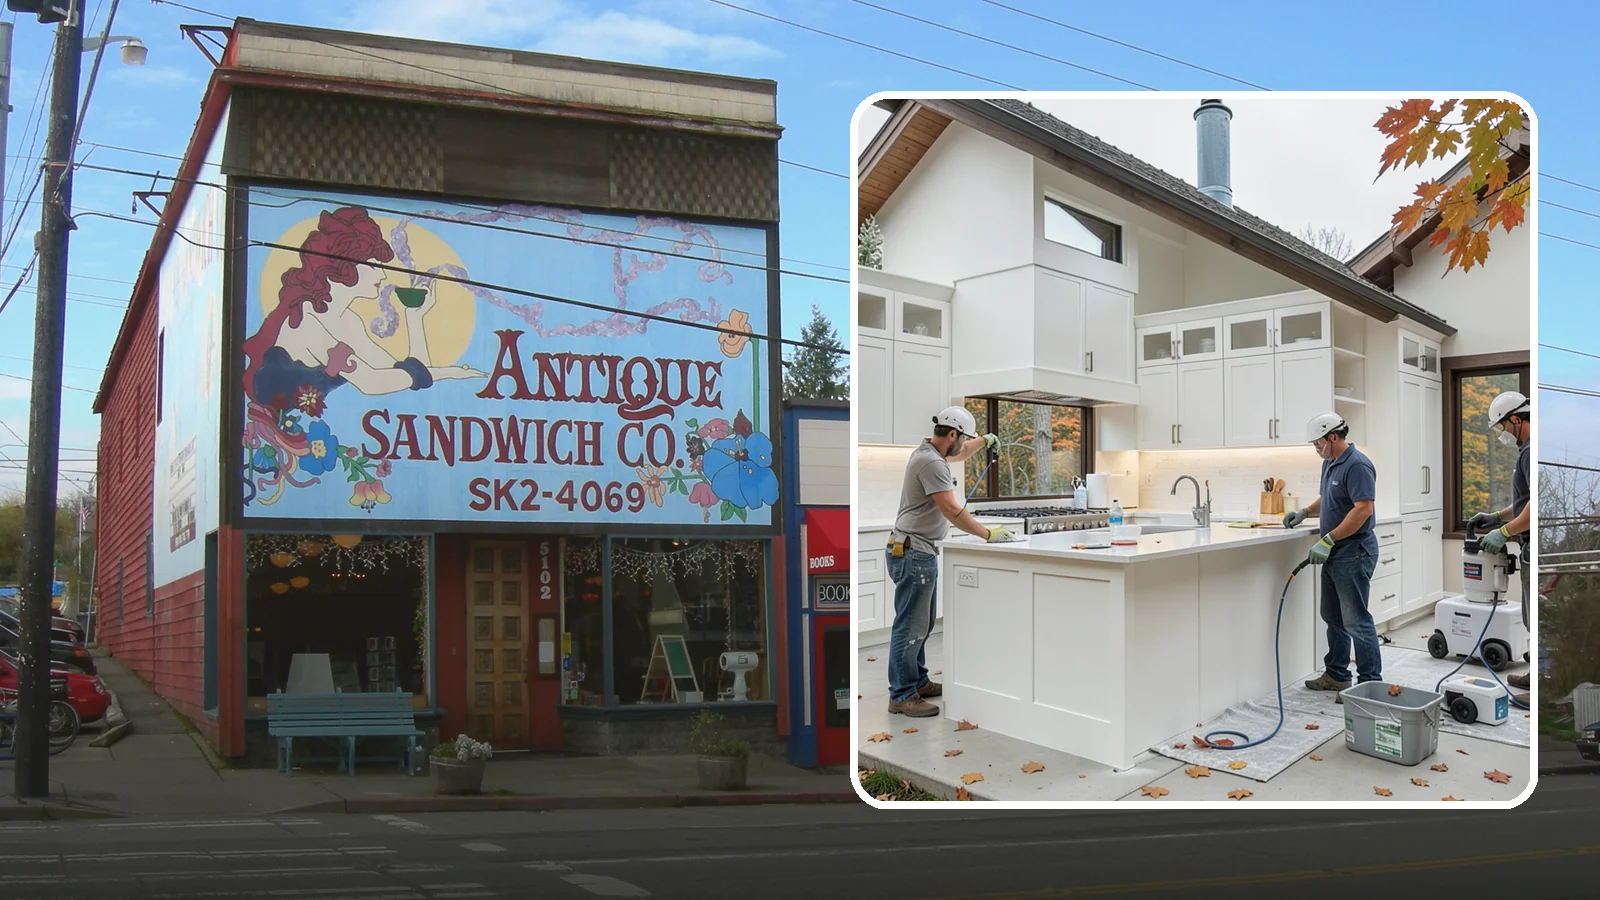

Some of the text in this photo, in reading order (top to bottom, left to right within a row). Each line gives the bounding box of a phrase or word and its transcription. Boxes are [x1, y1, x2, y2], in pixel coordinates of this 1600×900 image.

[476, 329, 723, 420] ANTIQUE
[362, 408, 685, 469] SANDWICH CO.
[468, 477, 646, 513] SK2-4069
[539, 541, 552, 600] 5102
[809, 555, 835, 569] BOOKS
